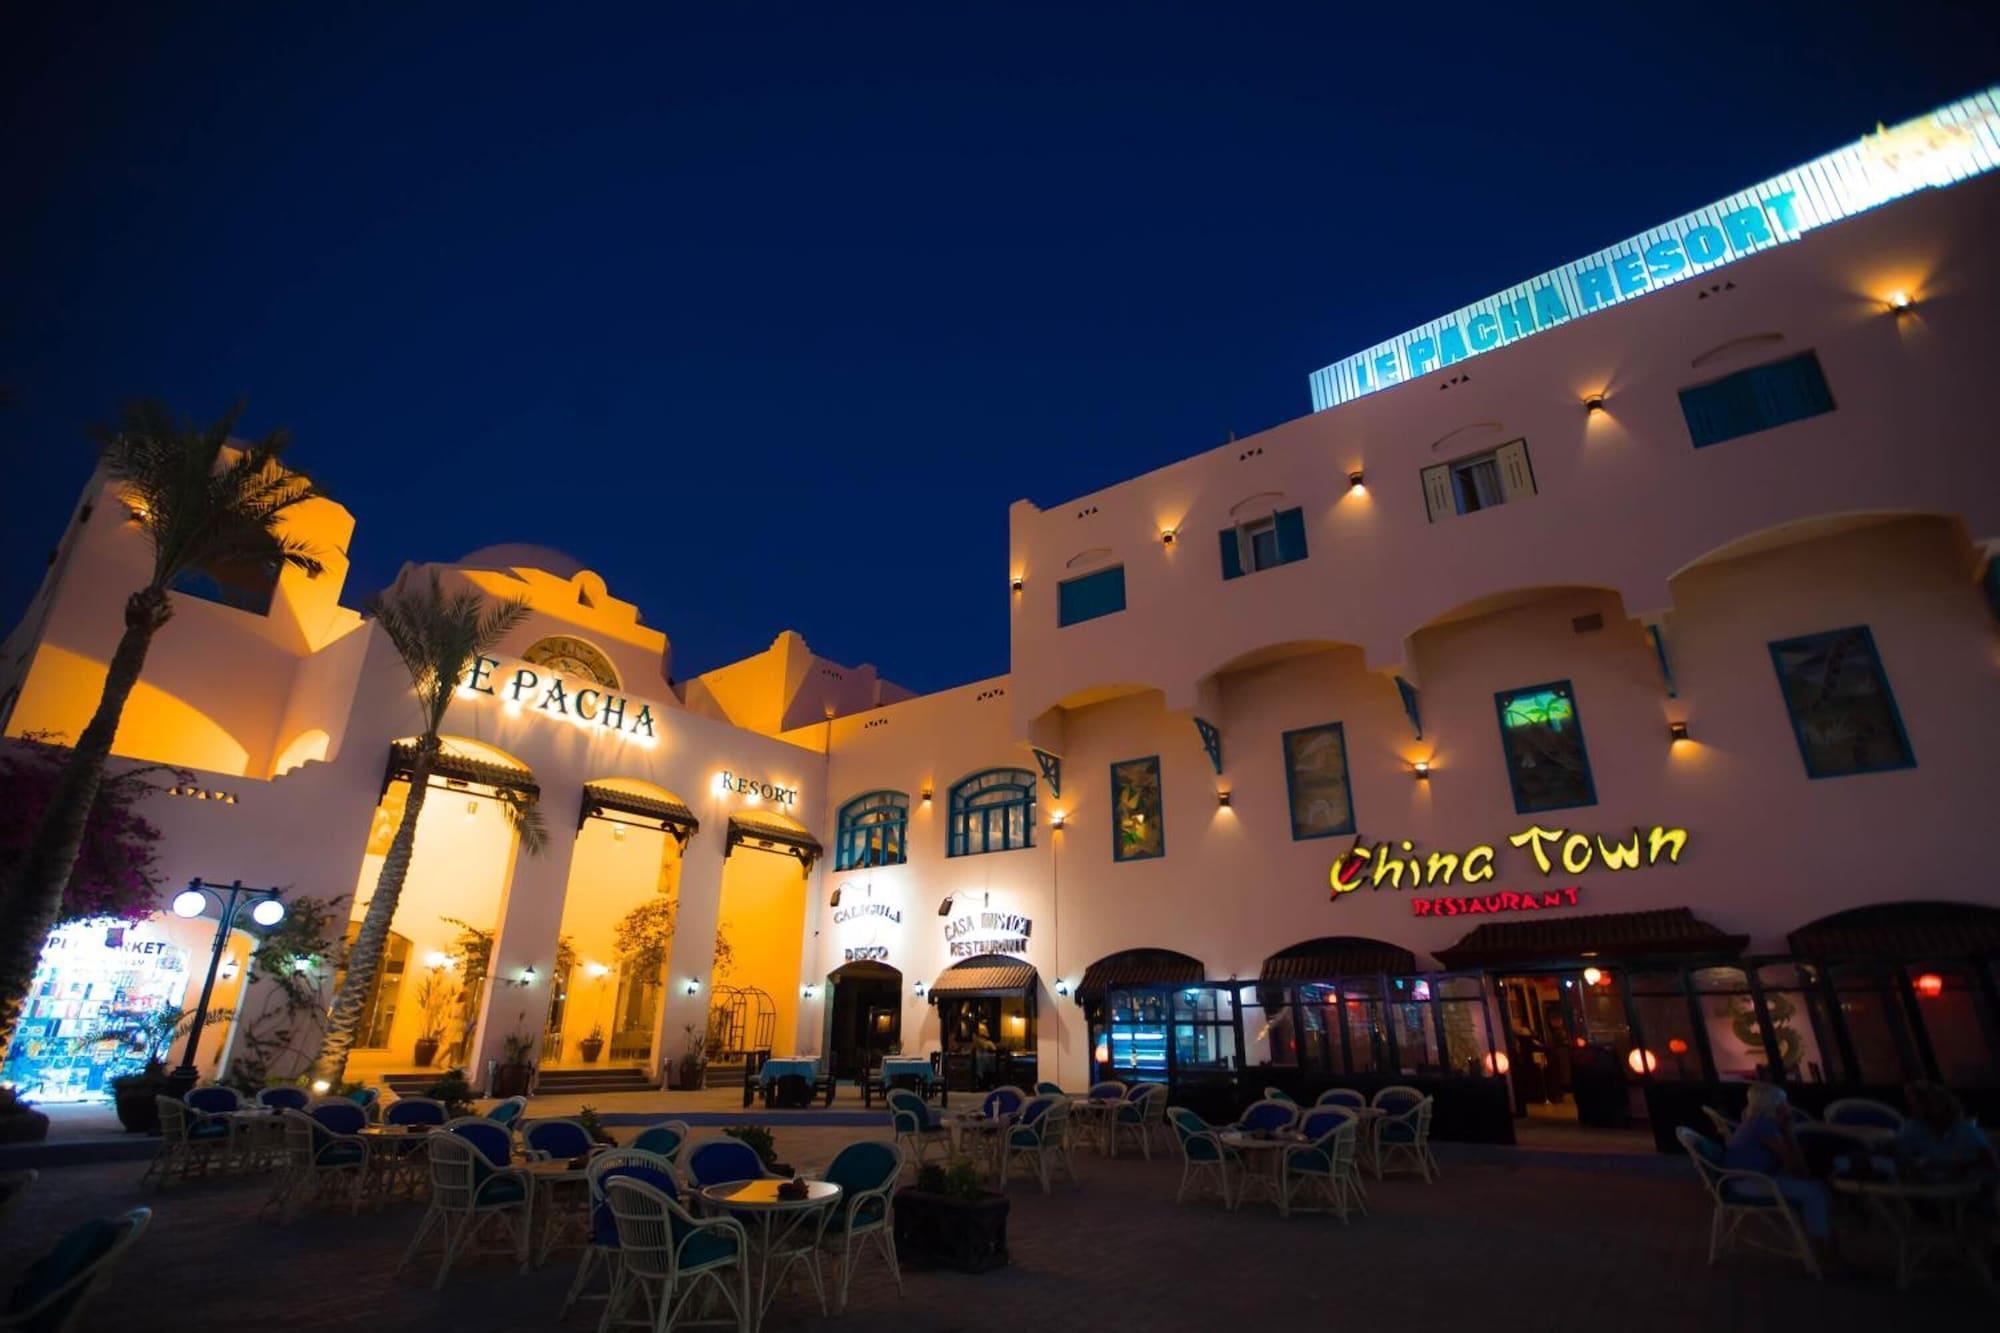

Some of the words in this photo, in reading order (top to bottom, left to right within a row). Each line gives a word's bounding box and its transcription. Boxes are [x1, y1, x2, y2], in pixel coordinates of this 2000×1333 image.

[1354, 349, 1400, 395] LE
[1407, 280, 1569, 379] PACHA
[1573, 190, 1803, 311] RESORT
[468, 655, 500, 696] E
[511, 668, 657, 738] PACHA
[721, 769, 798, 806] RESORT
[1329, 836, 1496, 900] China
[1411, 885, 1581, 918] RESTAURANT
[944, 915, 975, 941] CASA
[844, 945, 889, 961] DISCO
[950, 938, 1028, 957] RESTAURANT
